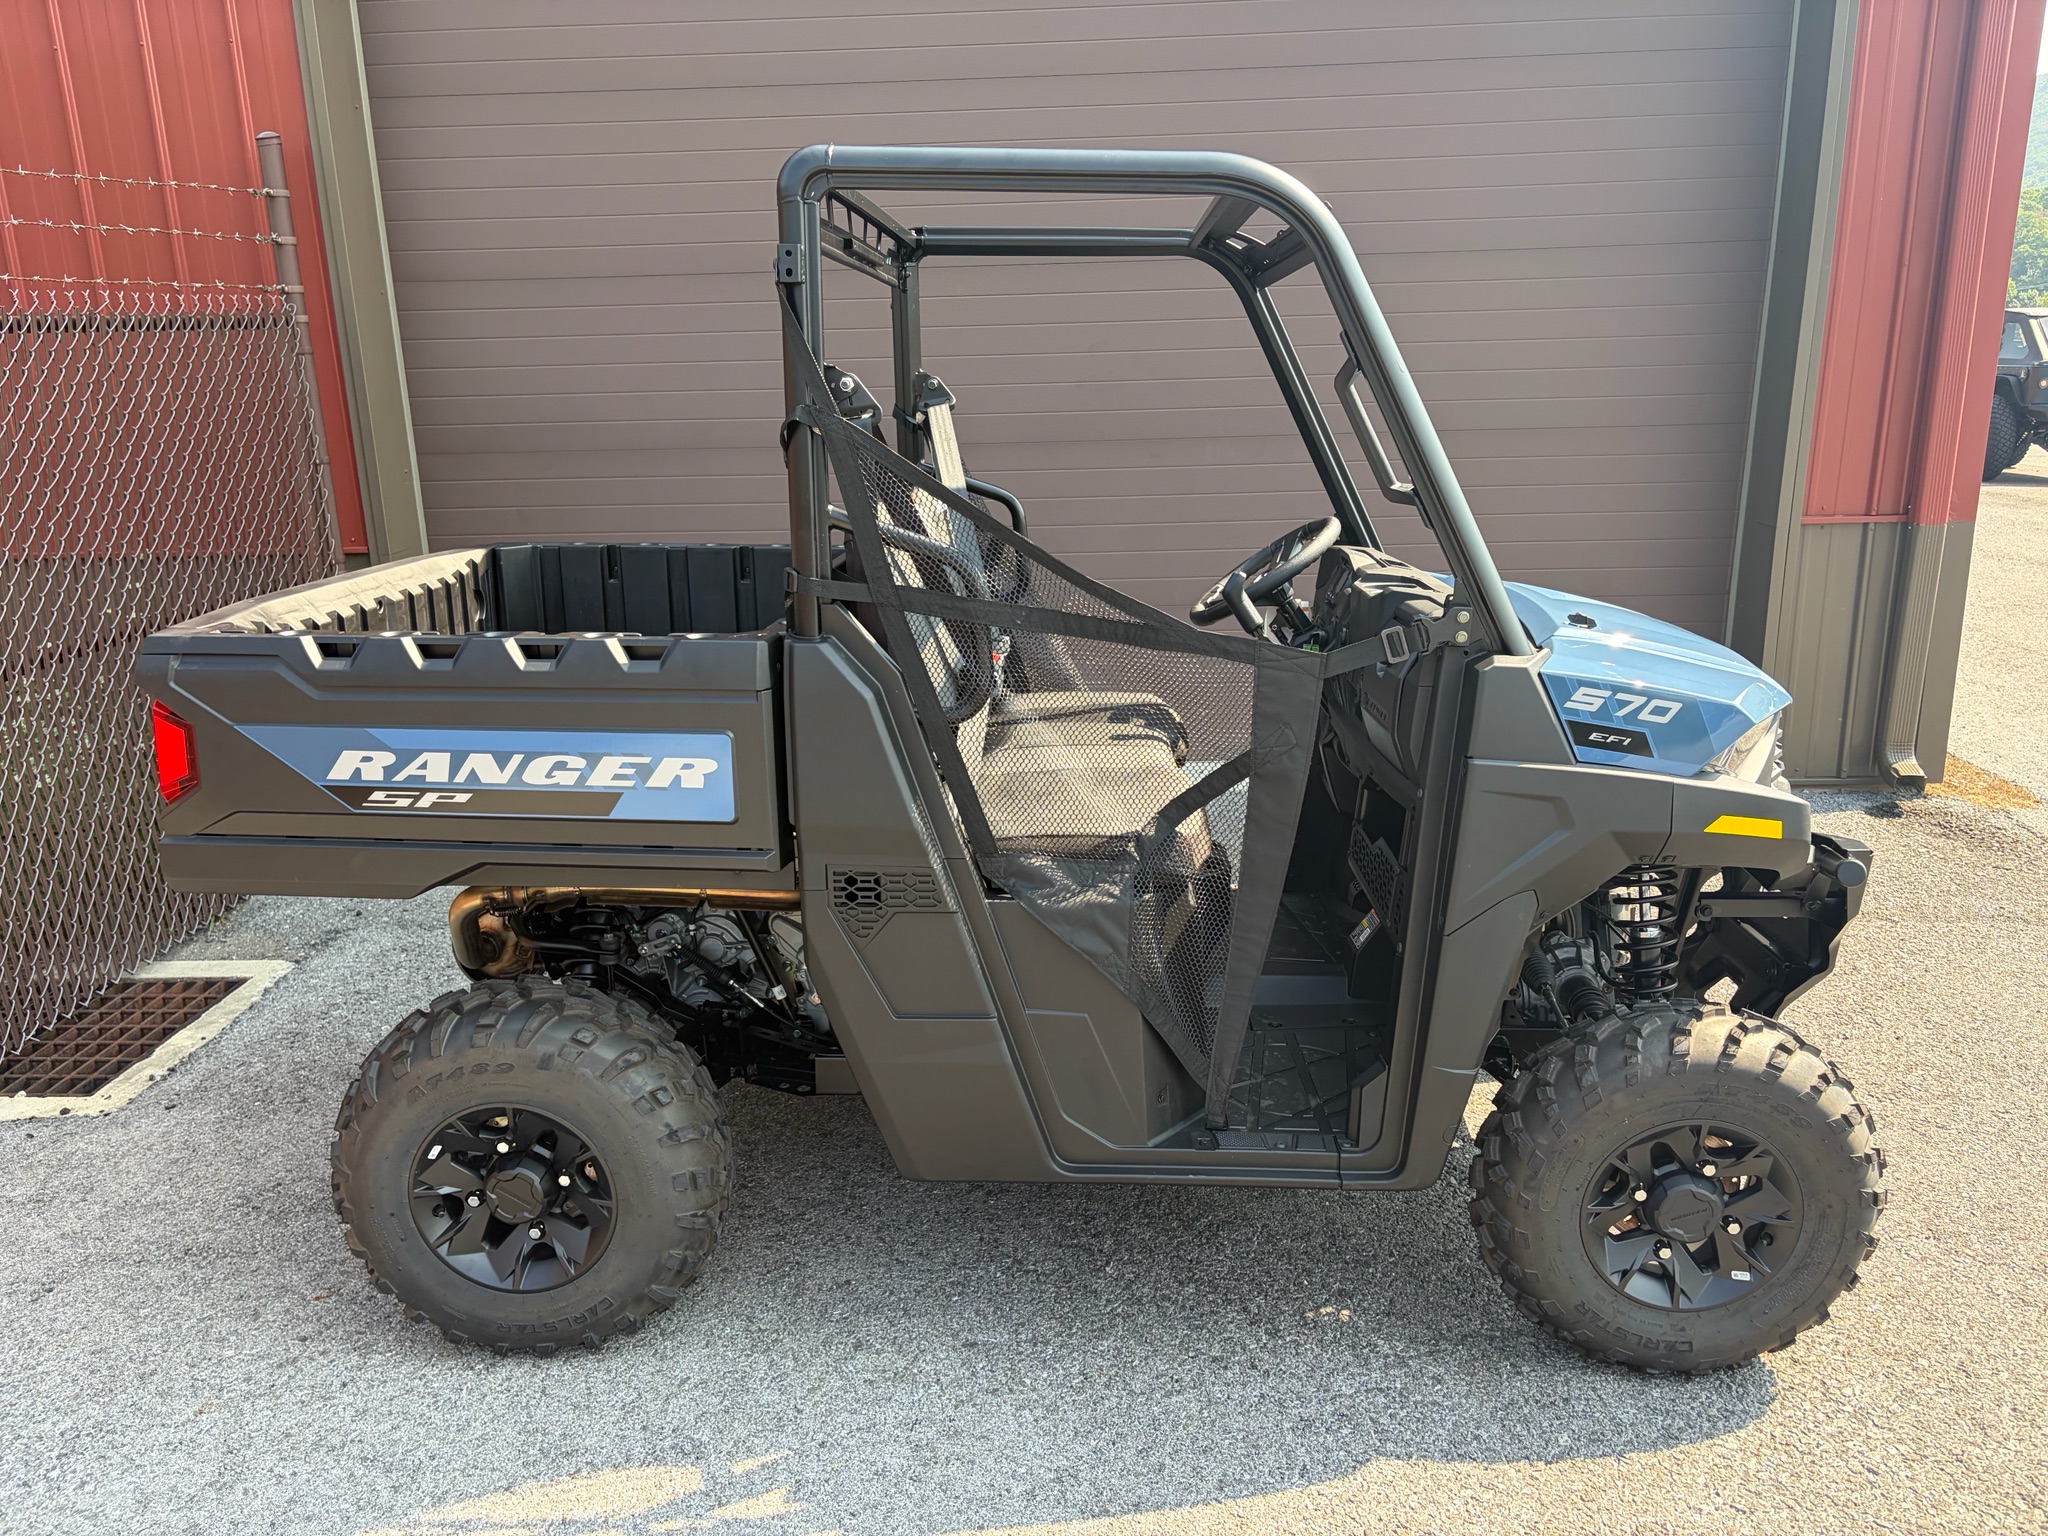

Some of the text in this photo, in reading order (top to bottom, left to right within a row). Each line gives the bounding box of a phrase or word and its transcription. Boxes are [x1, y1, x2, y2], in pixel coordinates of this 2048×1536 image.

[1563, 686, 1683, 724] 570
[1588, 731, 1632, 746] EFI
[326, 749, 718, 788] RANGER
[361, 790, 474, 808] SP
[496, 1295, 615, 1334] CARLSTAR
[1573, 1299, 1694, 1354] CARLSTAR
